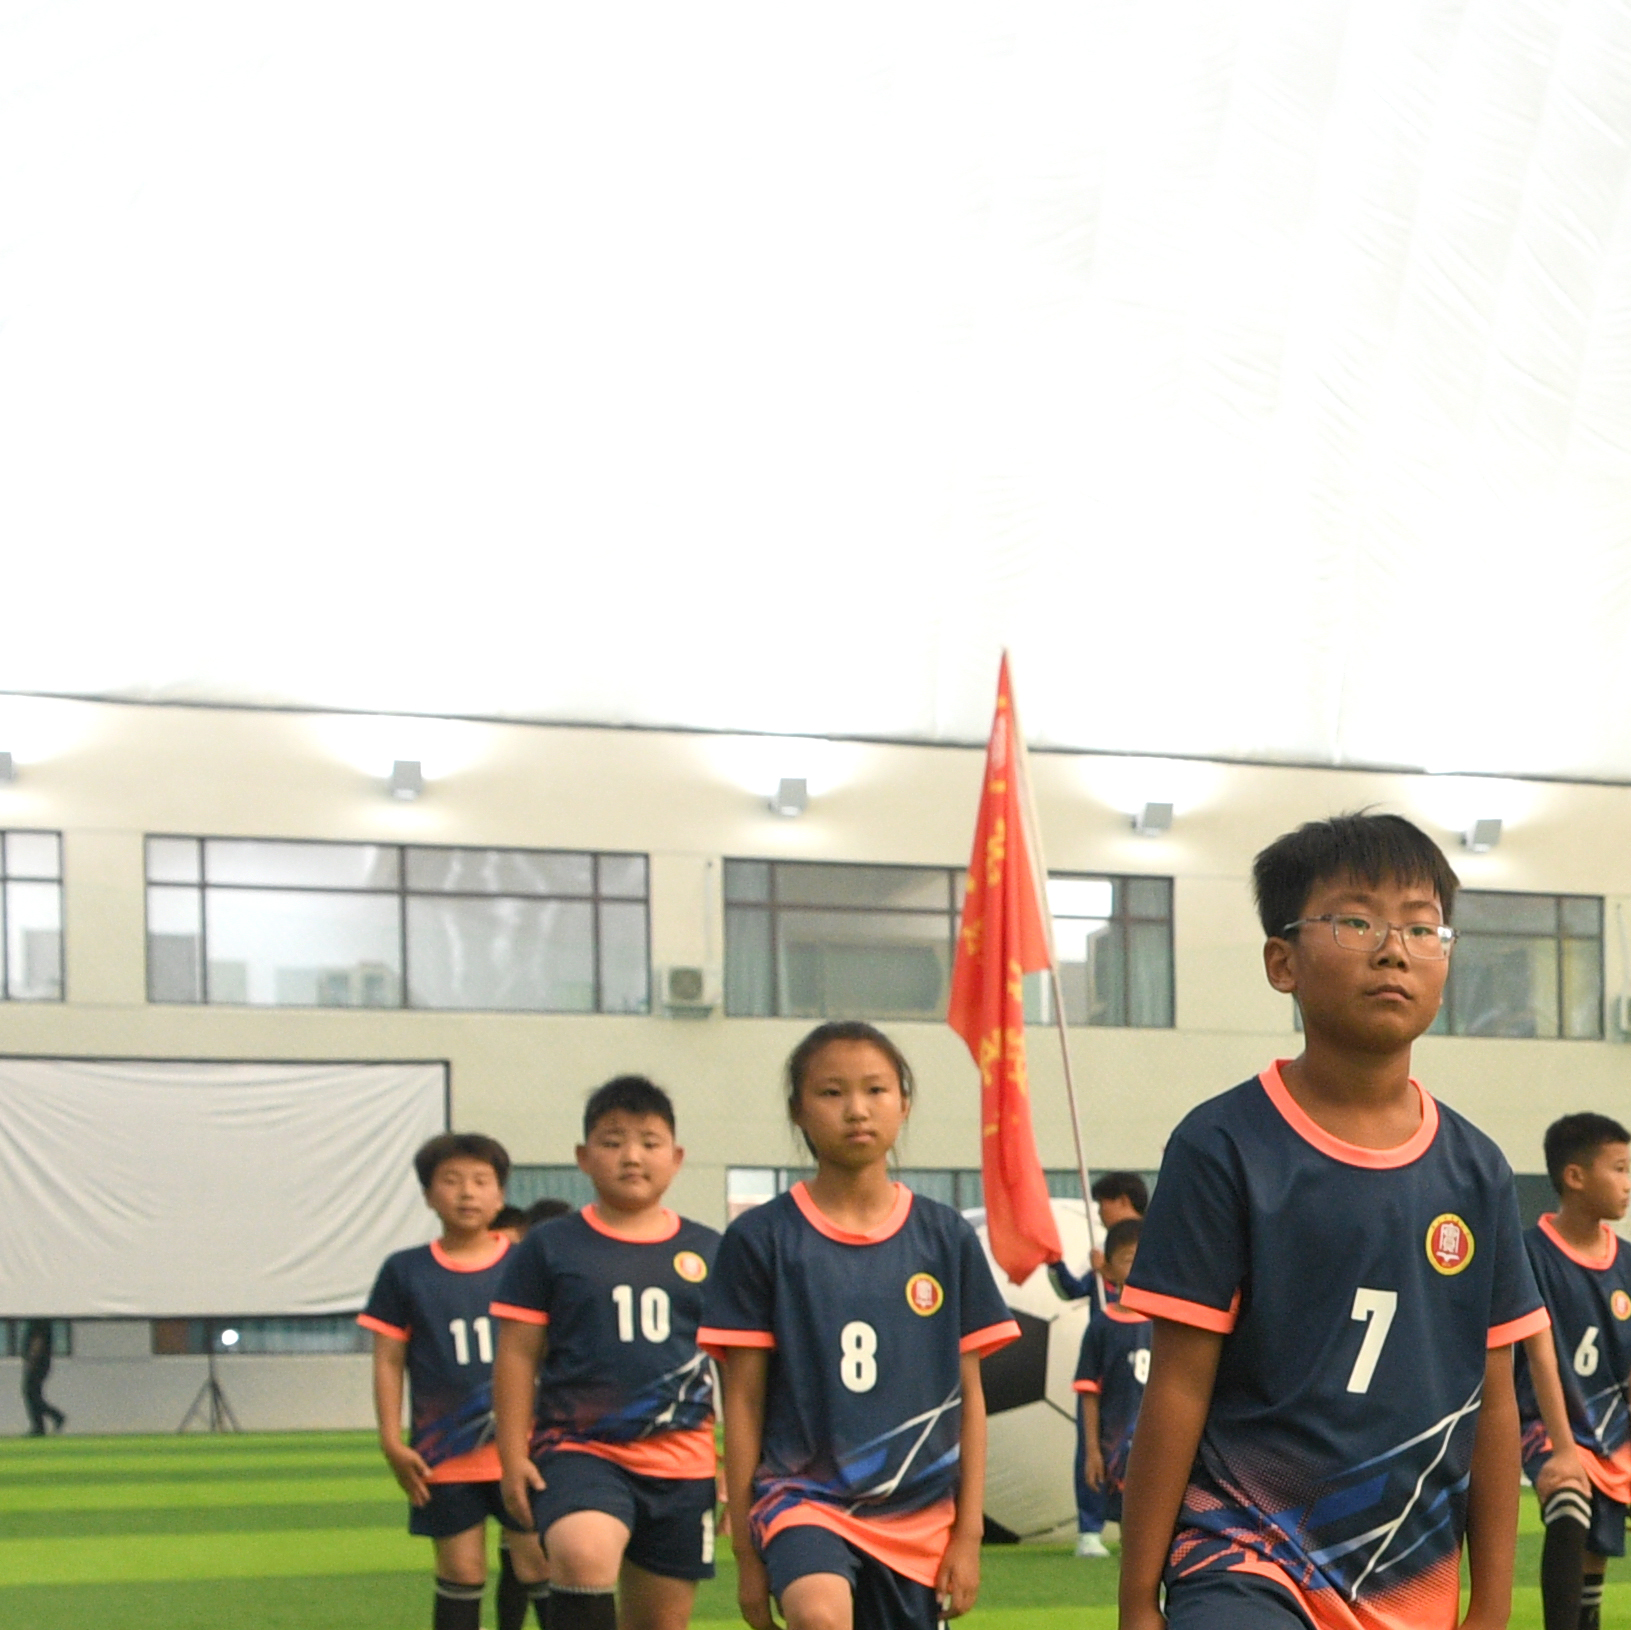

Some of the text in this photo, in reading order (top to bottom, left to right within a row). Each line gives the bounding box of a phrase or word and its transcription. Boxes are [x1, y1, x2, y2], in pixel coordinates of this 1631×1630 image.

[449, 1316, 494, 1366] 11
[612, 1284, 671, 1344] 10
[1346, 1287, 1398, 1394] 7
[840, 1320, 878, 1393] 8
[1573, 1325, 1599, 1377] 6
